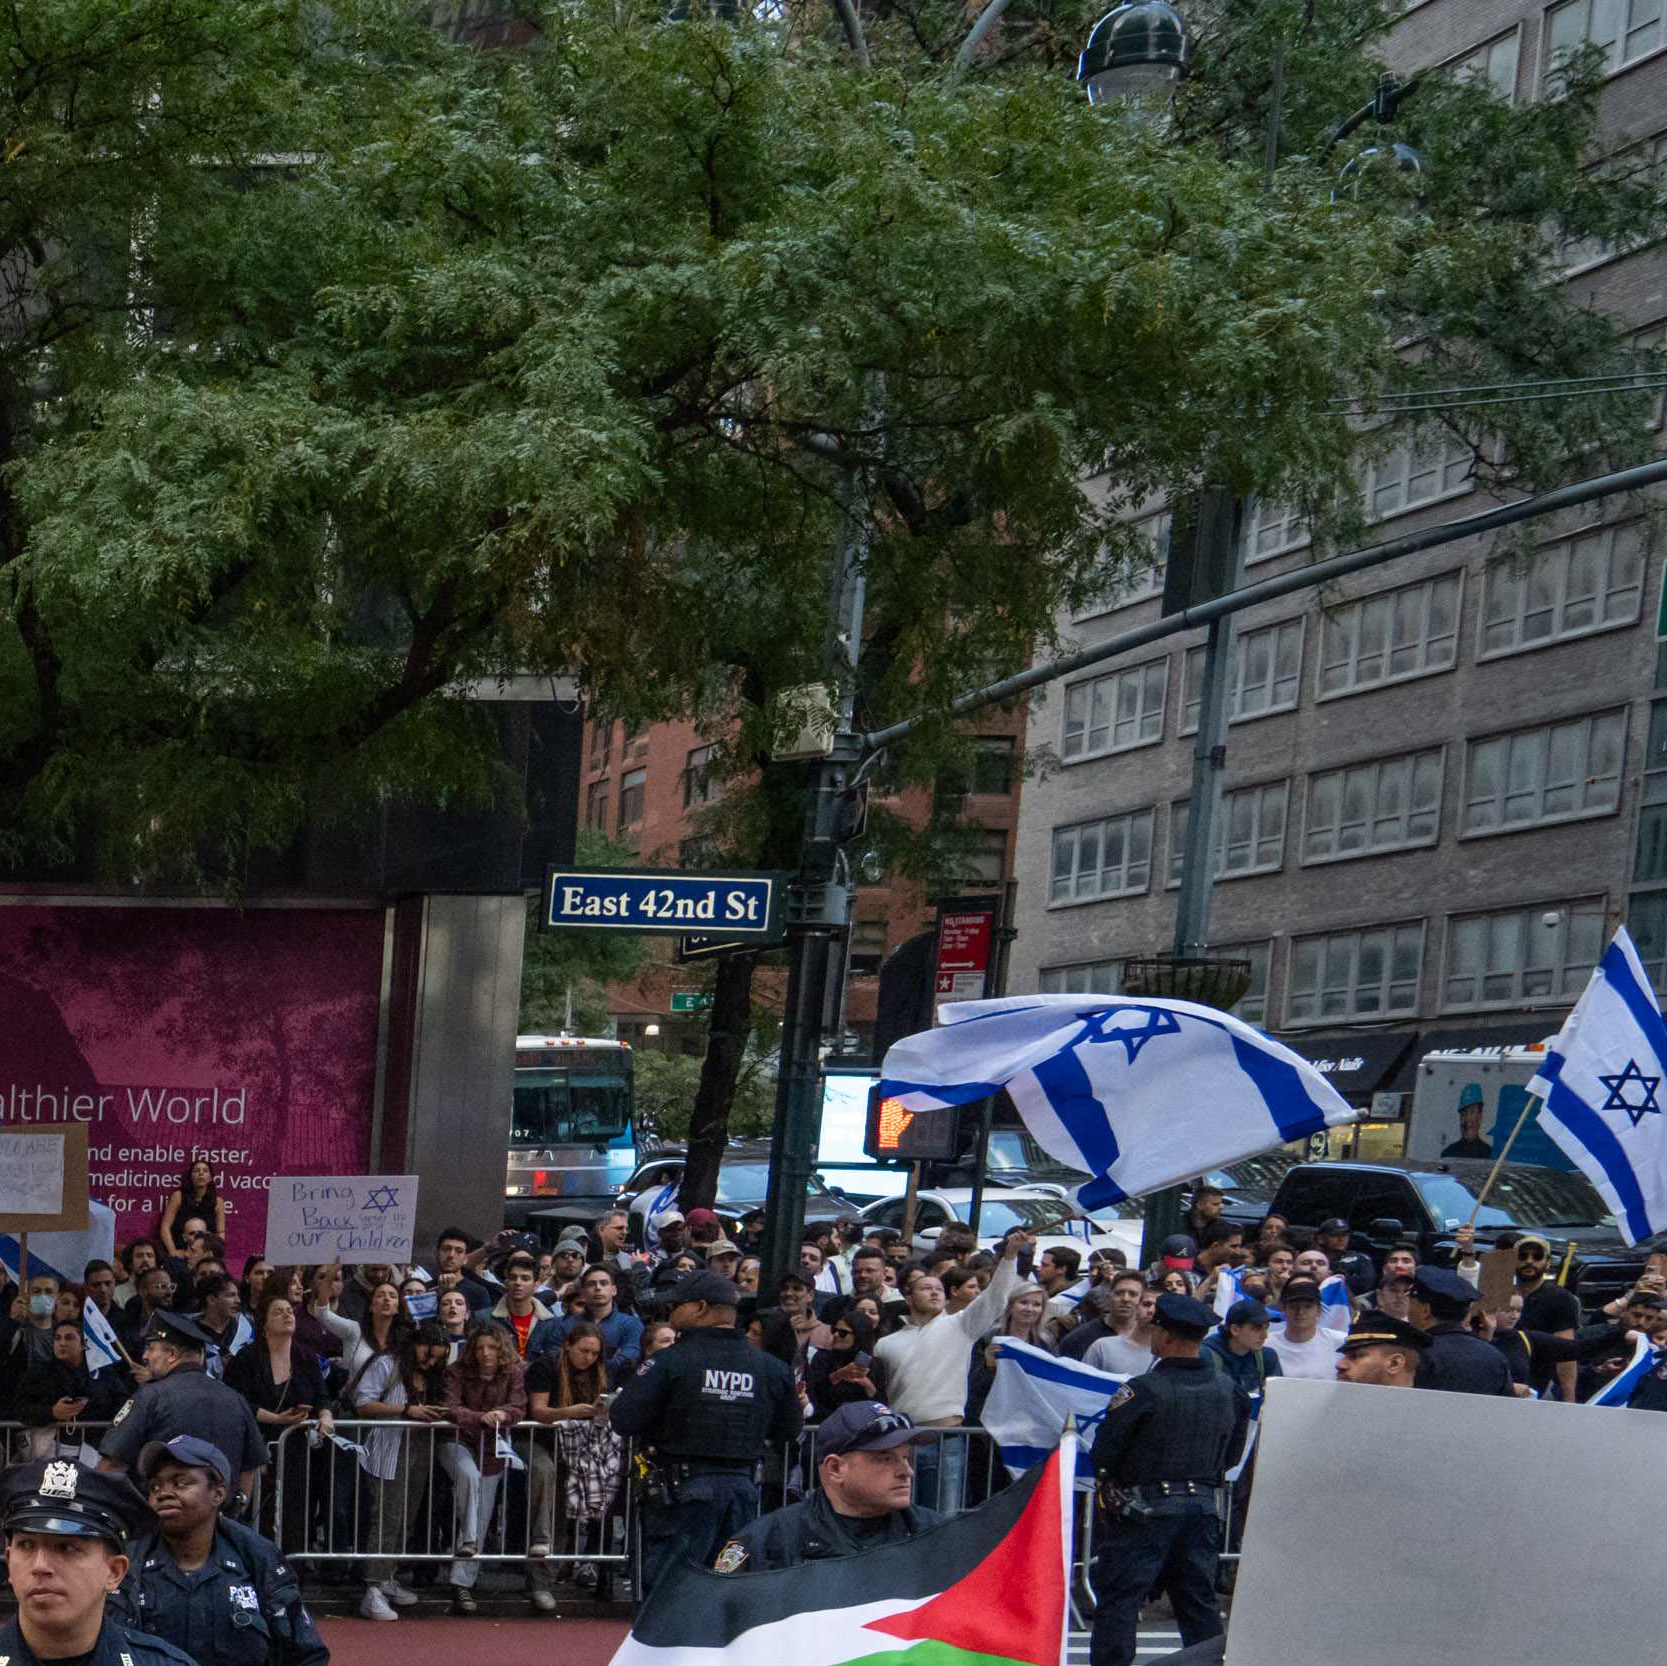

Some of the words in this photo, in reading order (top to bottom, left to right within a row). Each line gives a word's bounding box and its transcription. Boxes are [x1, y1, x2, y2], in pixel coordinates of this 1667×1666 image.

[560, 886, 635, 918] East
[639, 888, 717, 920] 42nd
[724, 893, 759, 922] St
[125, 1088, 247, 1126] World
[119, 1145, 185, 1164] enable
[190, 1145, 254, 1166] faster,
[87, 1169, 182, 1189] medicines
[118, 1194, 141, 1212] for
[142, 1199, 152, 1212] a
[291, 1182, 357, 1209] Bring
[301, 1206, 355, 1228] Back
[287, 1231, 327, 1248] our
[704, 1369, 753, 1393] NYPD
